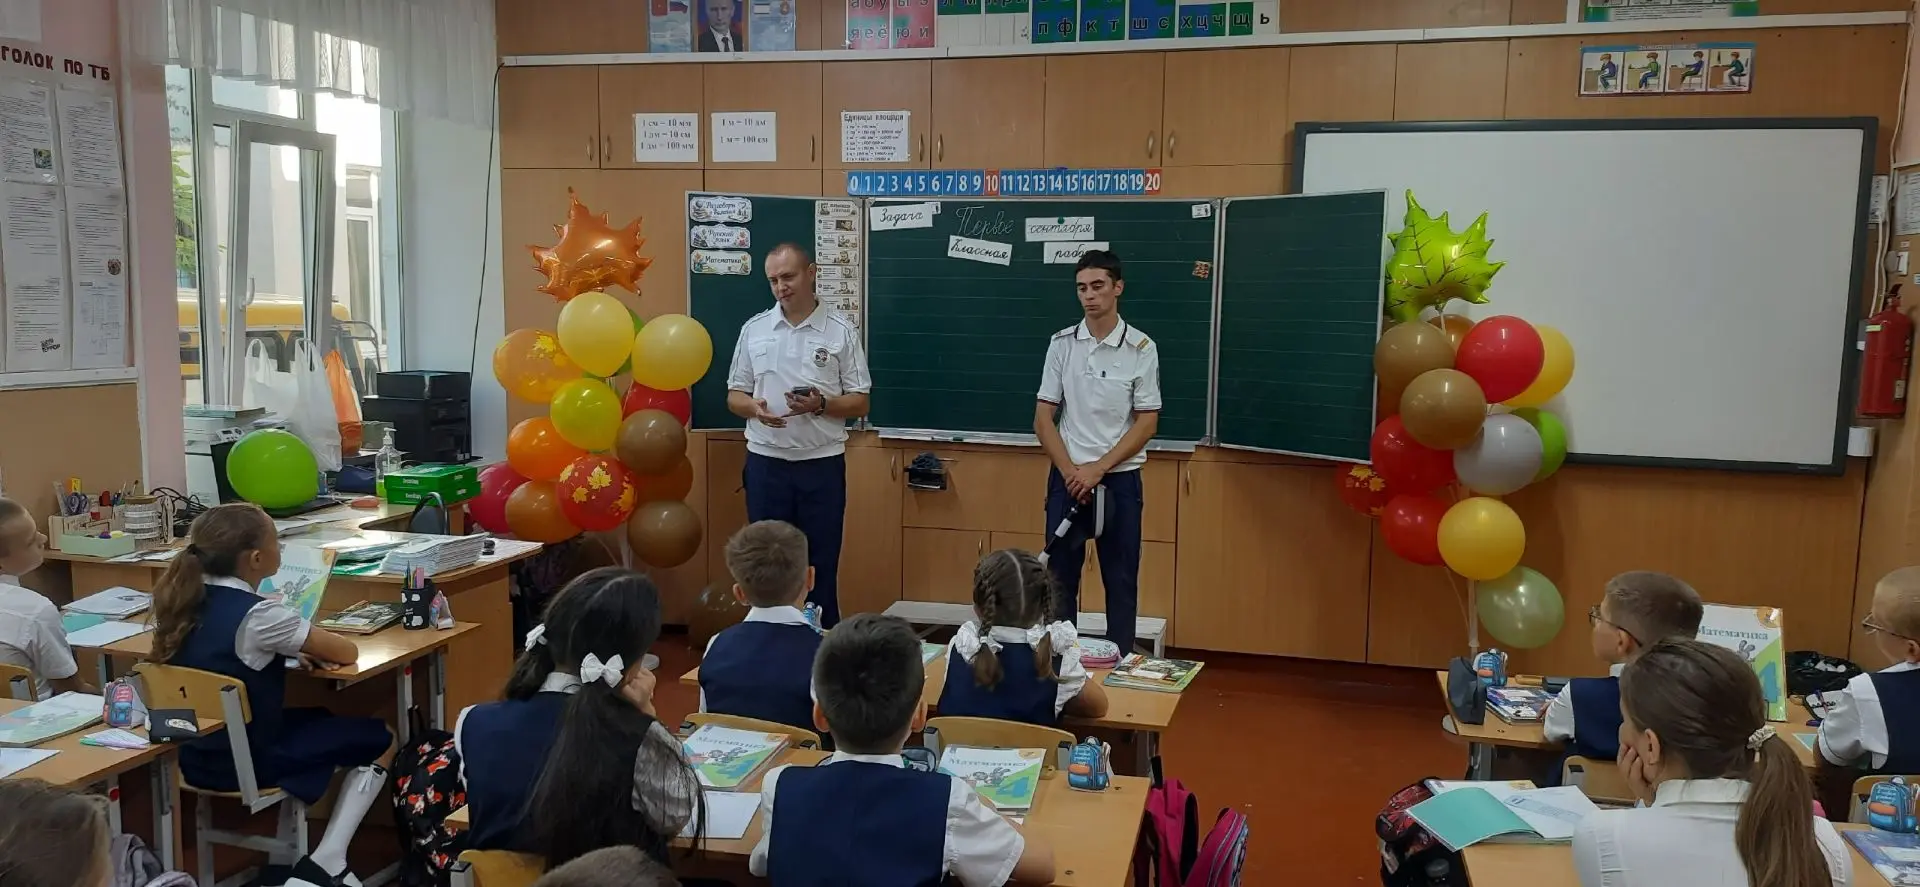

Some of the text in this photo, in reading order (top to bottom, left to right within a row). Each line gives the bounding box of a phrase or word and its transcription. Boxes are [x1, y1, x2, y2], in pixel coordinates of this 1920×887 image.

[1038, 18, 1073, 37] п ф
[1086, 19, 1119, 32] к т
[1133, 17, 1169, 30] ш с
[1181, 13, 1224, 30] х ц ч
[1233, 13, 1270, 28] щ ь
[850, 24, 887, 39] я е ё
[897, 27, 929, 38] ю и
[1, 45, 111, 80] ГОЛОК ПО ТБ
[844, 113, 904, 123] Единицы площади
[850, 173, 1160, 192] 0 1 2 3 4 5 6 7 8 9 10 11 12 13 14 15 16 17 18 19 20
[880, 208, 923, 227] Задача
[956, 205, 1014, 240] Первое
[1030, 218, 1092, 239] сентября
[951, 238, 1008, 259] Классная
[1053, 244, 1086, 264] рабо
[705, 255, 741, 264] Математика
[179, 686, 187, 698] 1
[697, 736, 767, 749] Математика
[948, 758, 1027, 767] Математика
[996, 776, 1029, 798] 4
